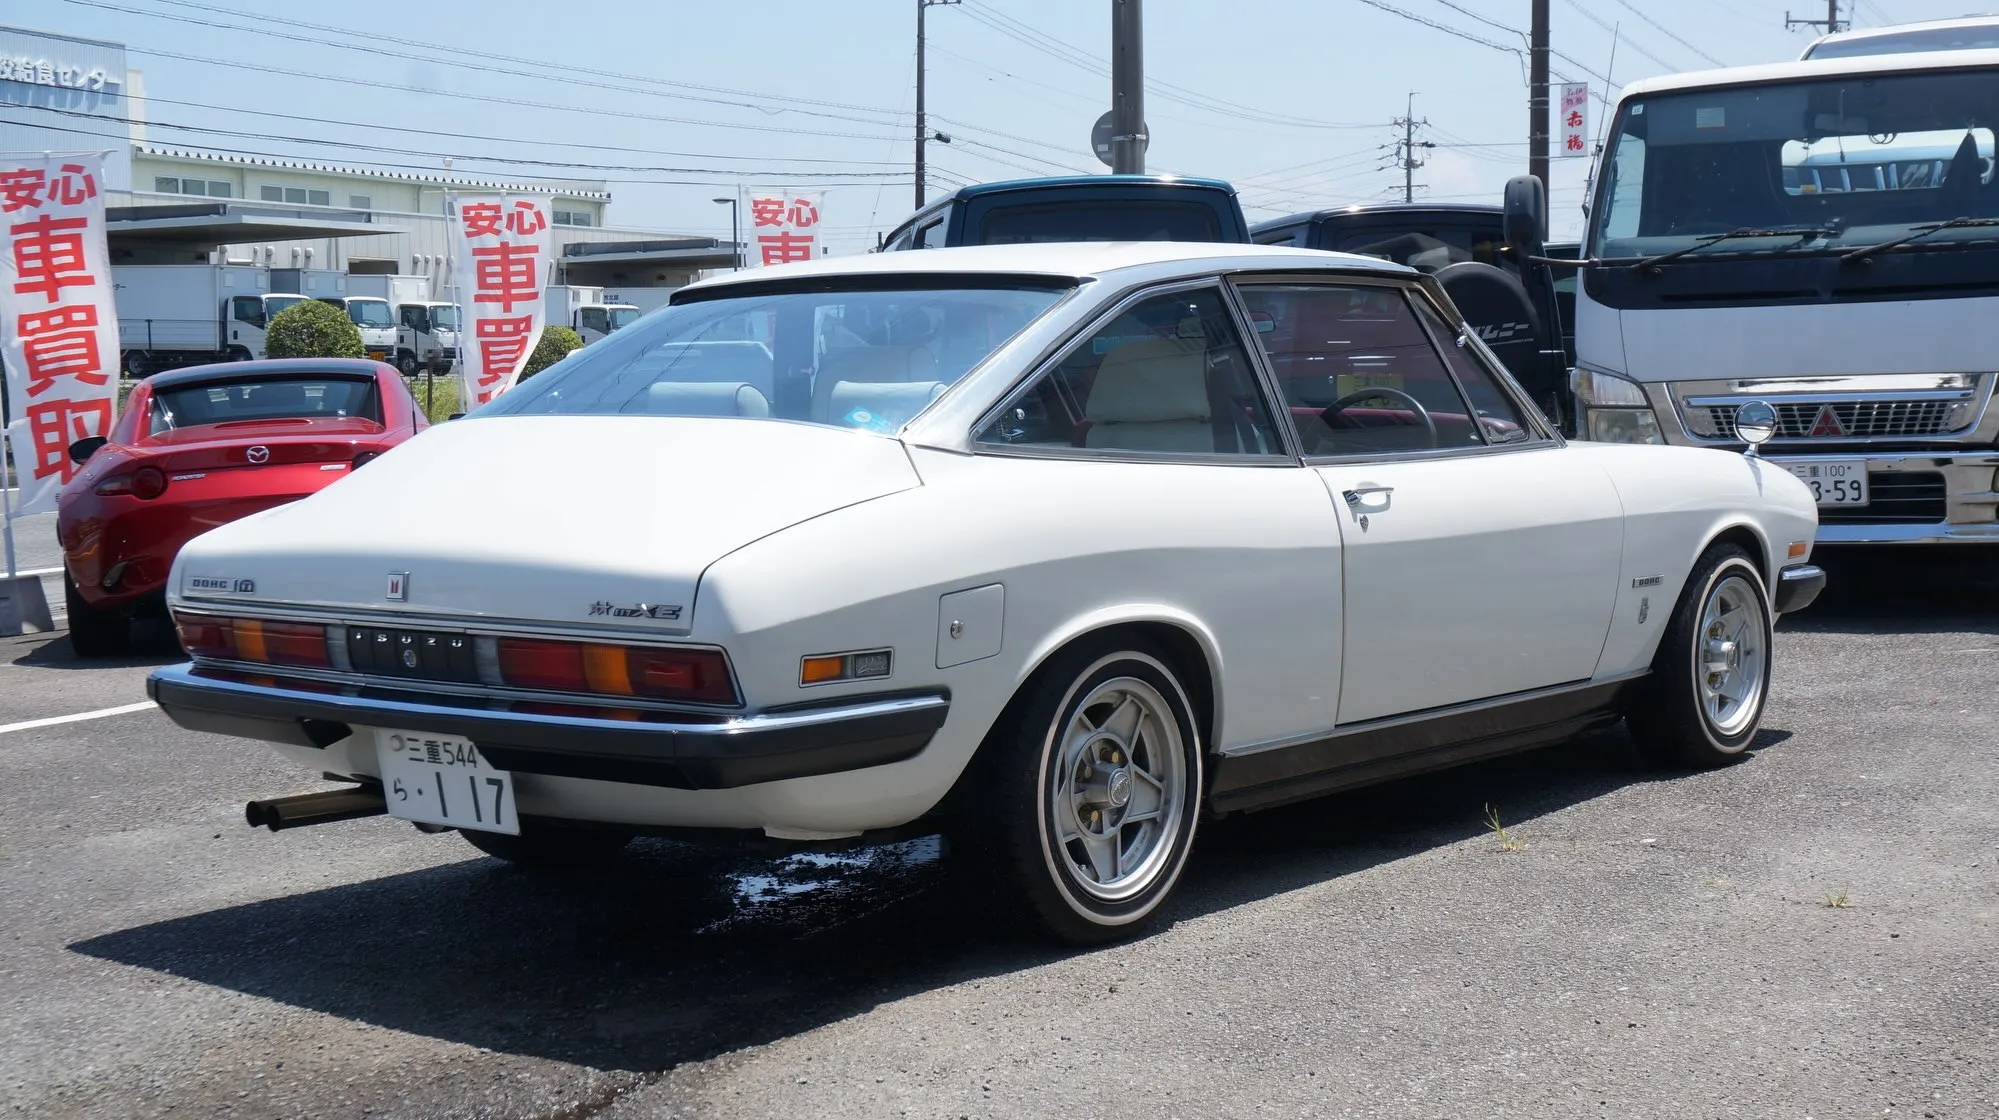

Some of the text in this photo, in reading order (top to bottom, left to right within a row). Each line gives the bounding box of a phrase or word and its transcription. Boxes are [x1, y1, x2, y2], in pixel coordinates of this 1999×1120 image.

[0, 164, 96, 212] 安心
[462, 201, 546, 238] 安心
[752, 198, 818, 227] 安心
[472, 241, 540, 405] 車買
[192, 579, 228, 588] DOHC
